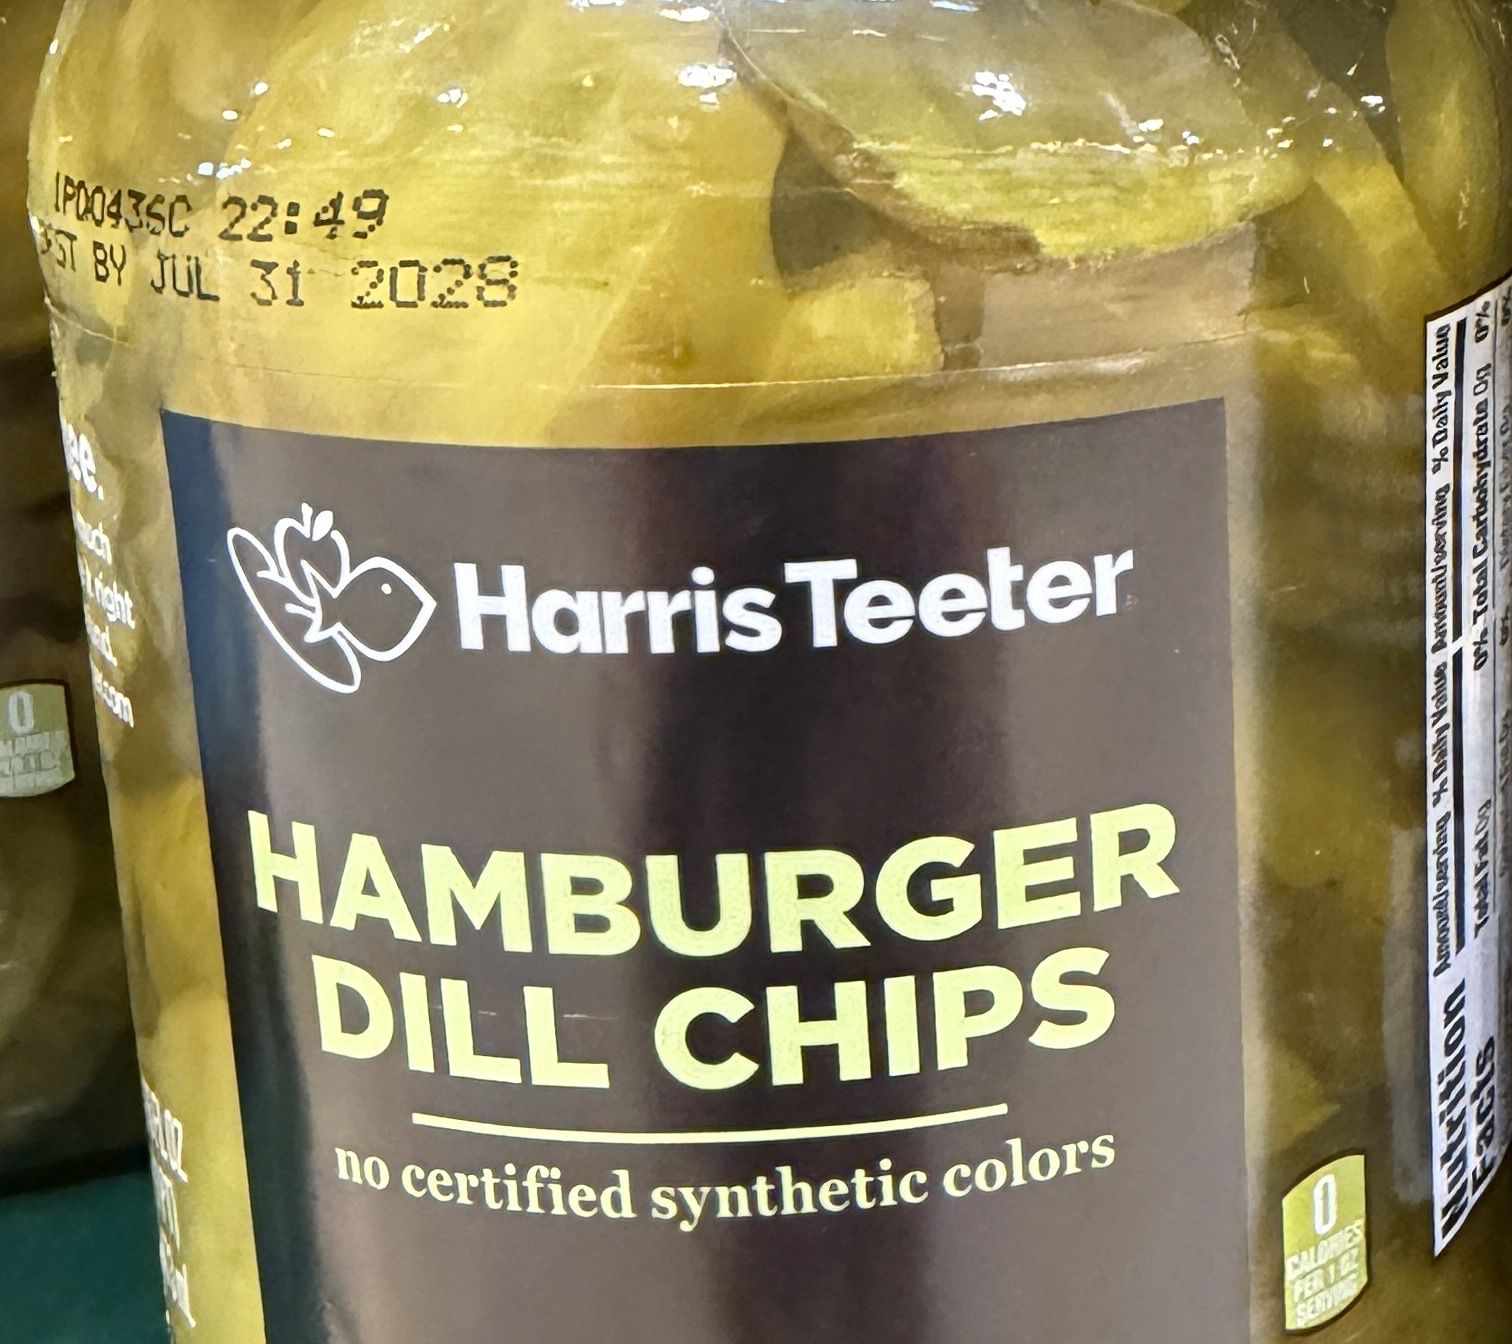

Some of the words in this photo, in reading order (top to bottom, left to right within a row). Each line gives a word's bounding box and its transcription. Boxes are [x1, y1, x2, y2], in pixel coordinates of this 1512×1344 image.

[218, 189, 390, 242] 22:49
[93, 239, 128, 286] BY
[150, 248, 220, 302] JUL
[250, 259, 304, 308] 31
[350, 255, 519, 309] 2028
[452, 560, 782, 655] Harris
[784, 547, 1134, 648] Teeter
[1471, 557, 1489, 623] Total
[9, 691, 34, 734] 0
[246, 802, 1181, 957] HAMBURGER
[311, 953, 610, 1089] DILL
[653, 946, 1116, 1091] CHIPS
[1438, 978, 1467, 1238] Nutrition
[1469, 1035, 1497, 1198] Facts
[334, 1144, 390, 1192] no
[400, 1159, 636, 1220] certified
[649, 1158, 929, 1232] synthetic
[942, 1128, 1116, 1199] colors
